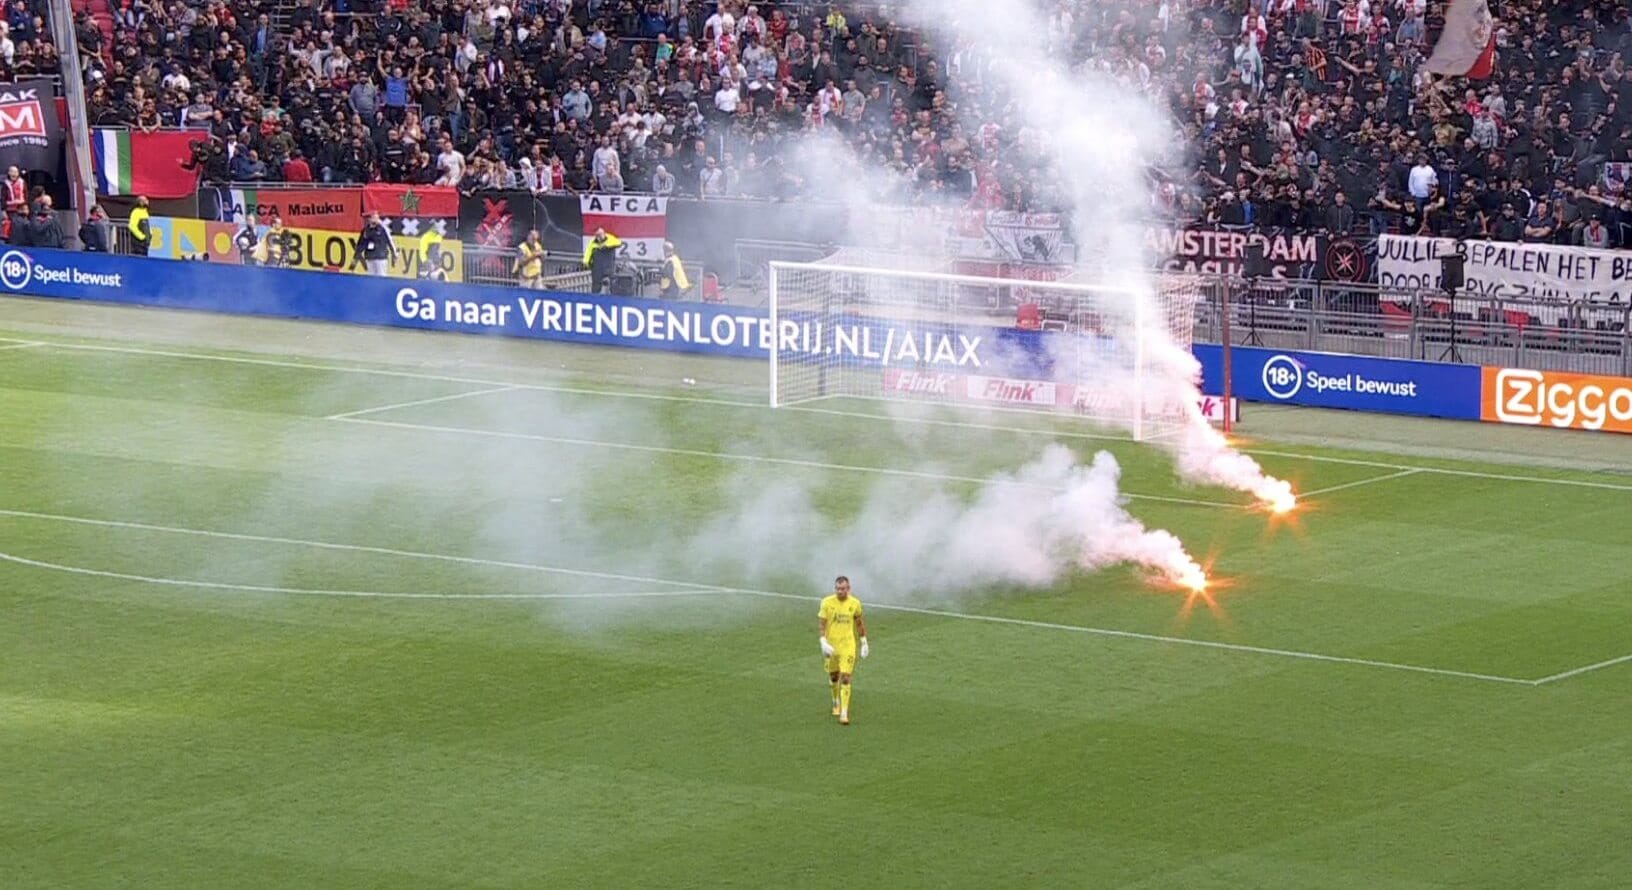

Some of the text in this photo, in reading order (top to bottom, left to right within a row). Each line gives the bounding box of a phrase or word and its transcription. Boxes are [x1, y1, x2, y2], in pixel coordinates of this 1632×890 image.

[288, 202, 344, 216] Maluku
[589, 198, 659, 212] AFCA
[4, 261, 26, 278] 18+
[1379, 239, 1441, 263] JULLIE
[1558, 254, 1600, 280] HET
[34, 264, 122, 287] Speel bewust
[396, 288, 436, 320] Ga
[445, 300, 512, 326] naar
[896, 373, 947, 394] Flink
[1268, 367, 1297, 386] 18+
[1306, 371, 1417, 397] Speel bewust
[983, 380, 1034, 402] Flink
[1496, 368, 1632, 430] Ziggo
